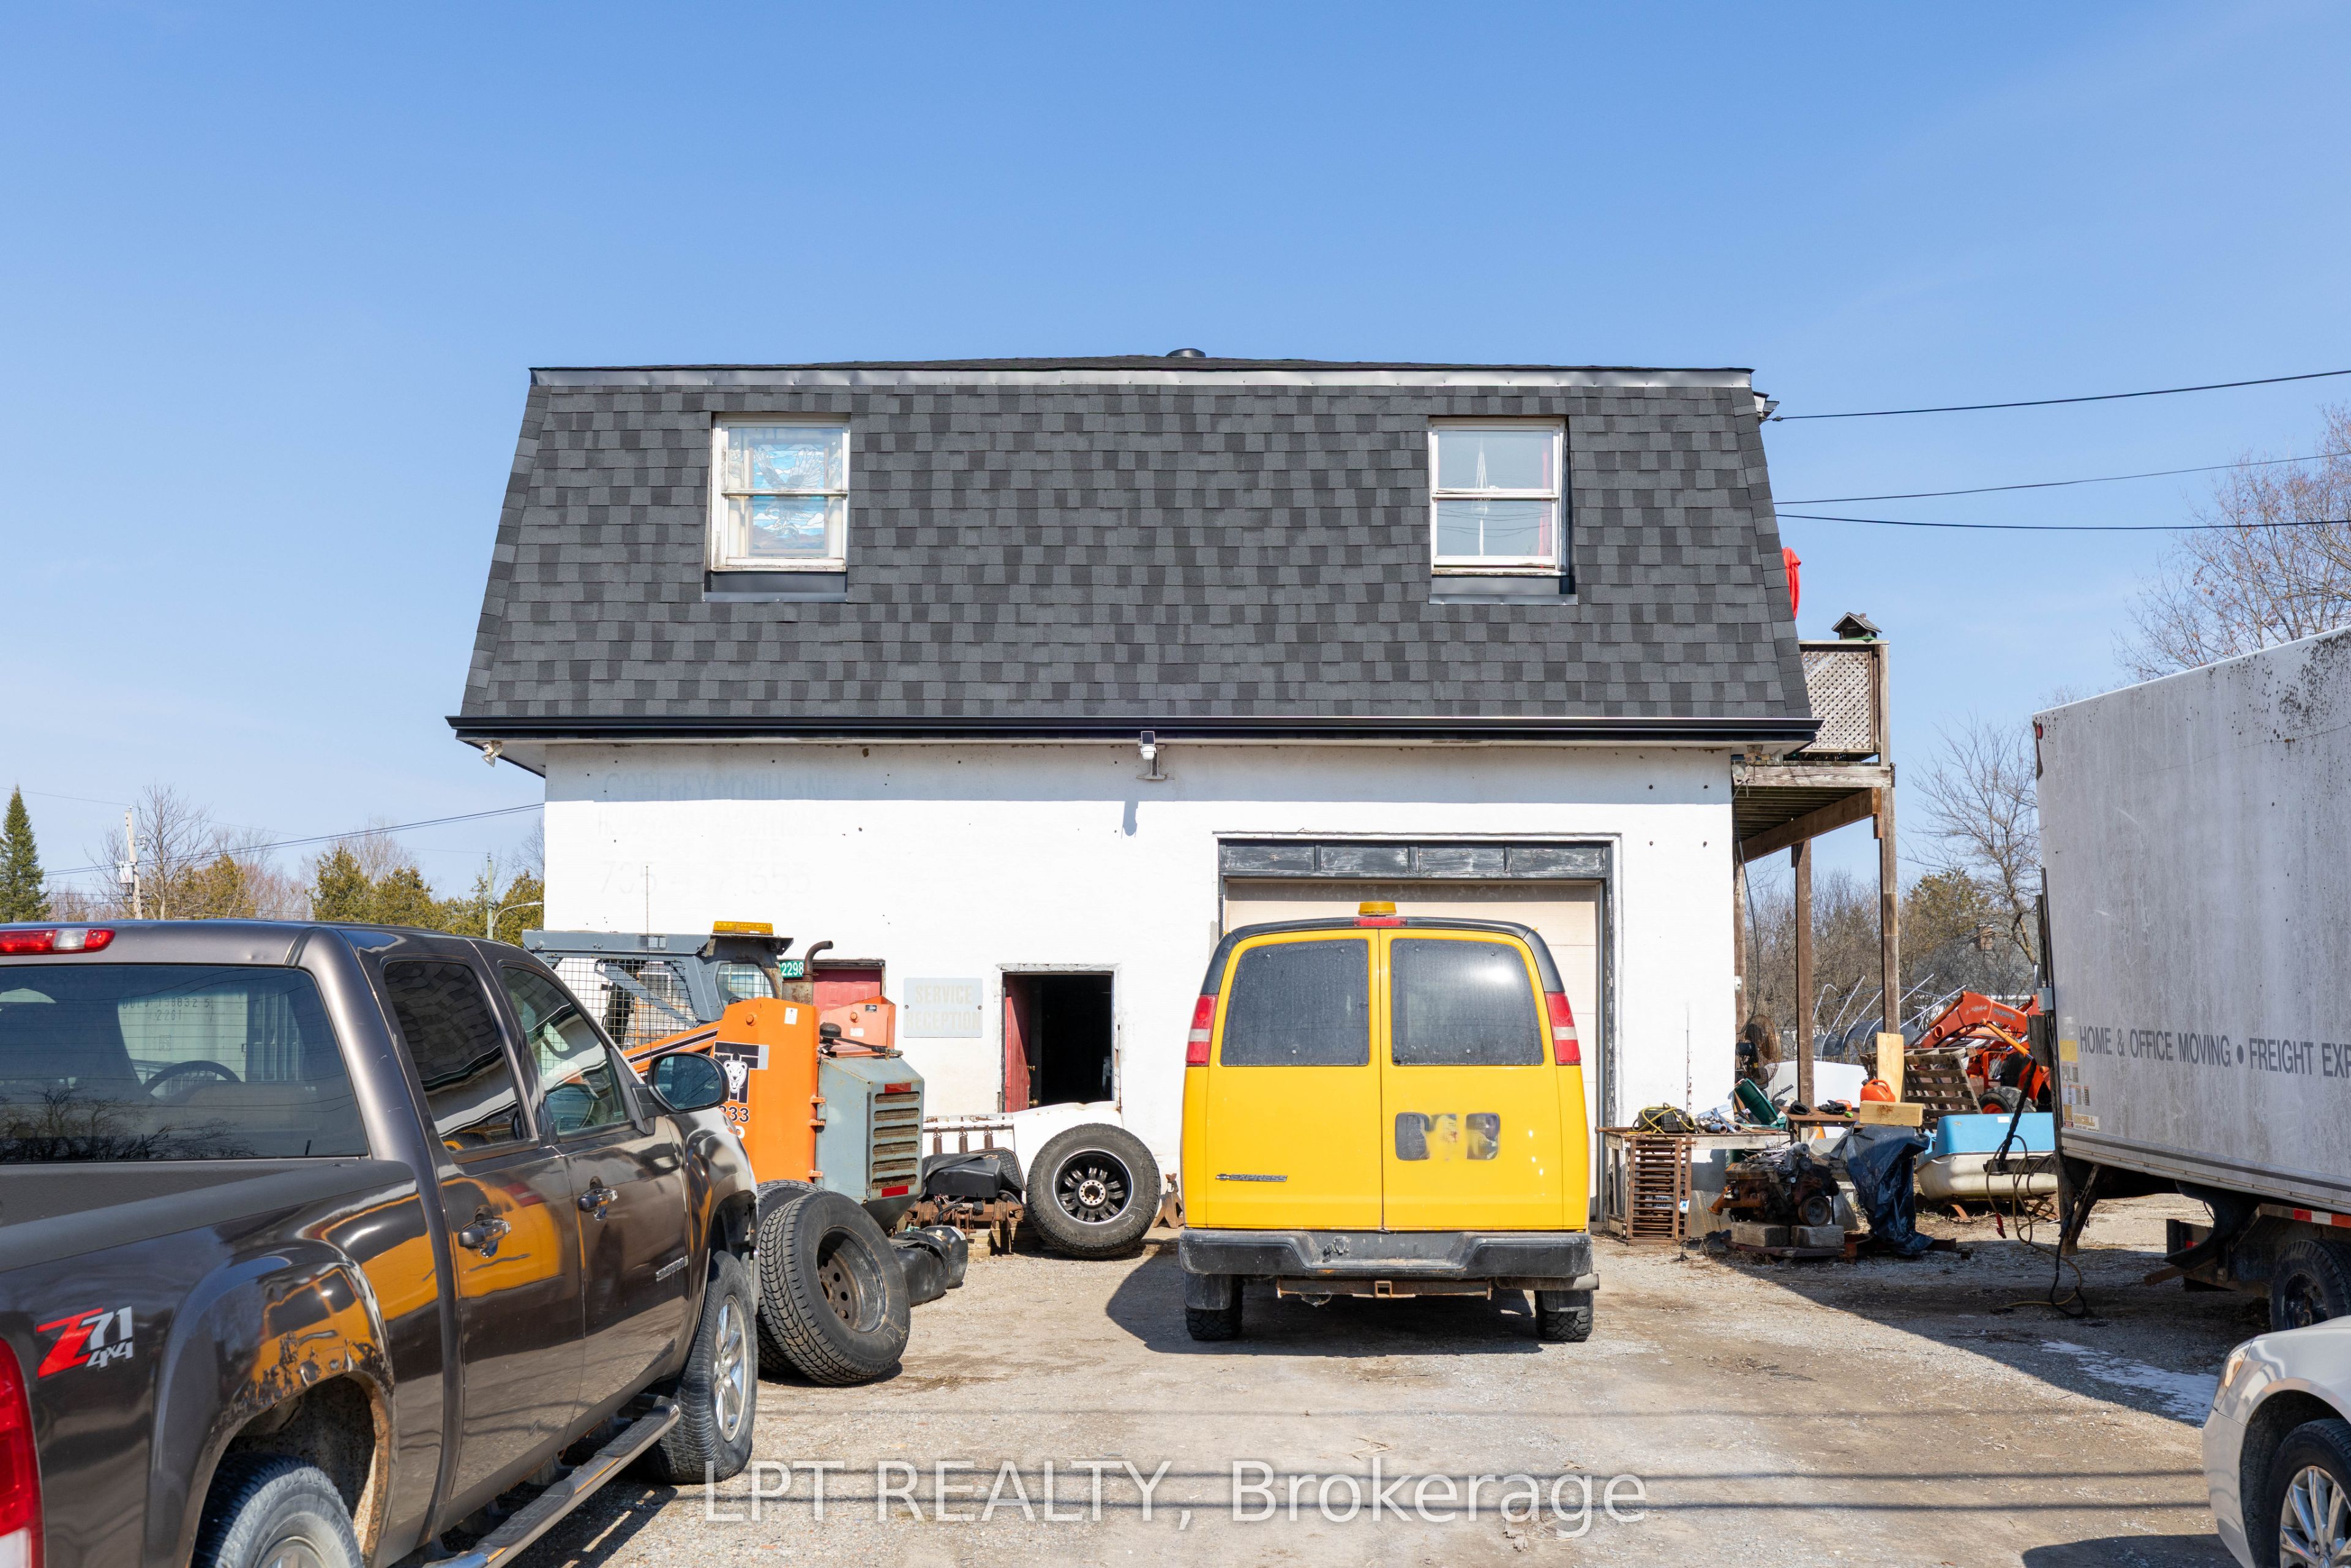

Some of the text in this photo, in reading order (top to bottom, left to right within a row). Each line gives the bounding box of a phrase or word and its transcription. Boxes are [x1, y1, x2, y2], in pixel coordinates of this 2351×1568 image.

[779, 962, 804, 976] 2298
[915, 985, 972, 1004] SERVICE
[906, 1010, 981, 1030] RECEPTION
[2079, 1026, 2112, 1055] HOME
[2117, 1028, 2125, 1057] &
[2129, 1028, 2173, 1061] OFFICE
[2178, 1032, 2232, 1067] MOVING
[2249, 1037, 2314, 1075] FREIGHT
[36, 1306, 133, 1378] Z71
